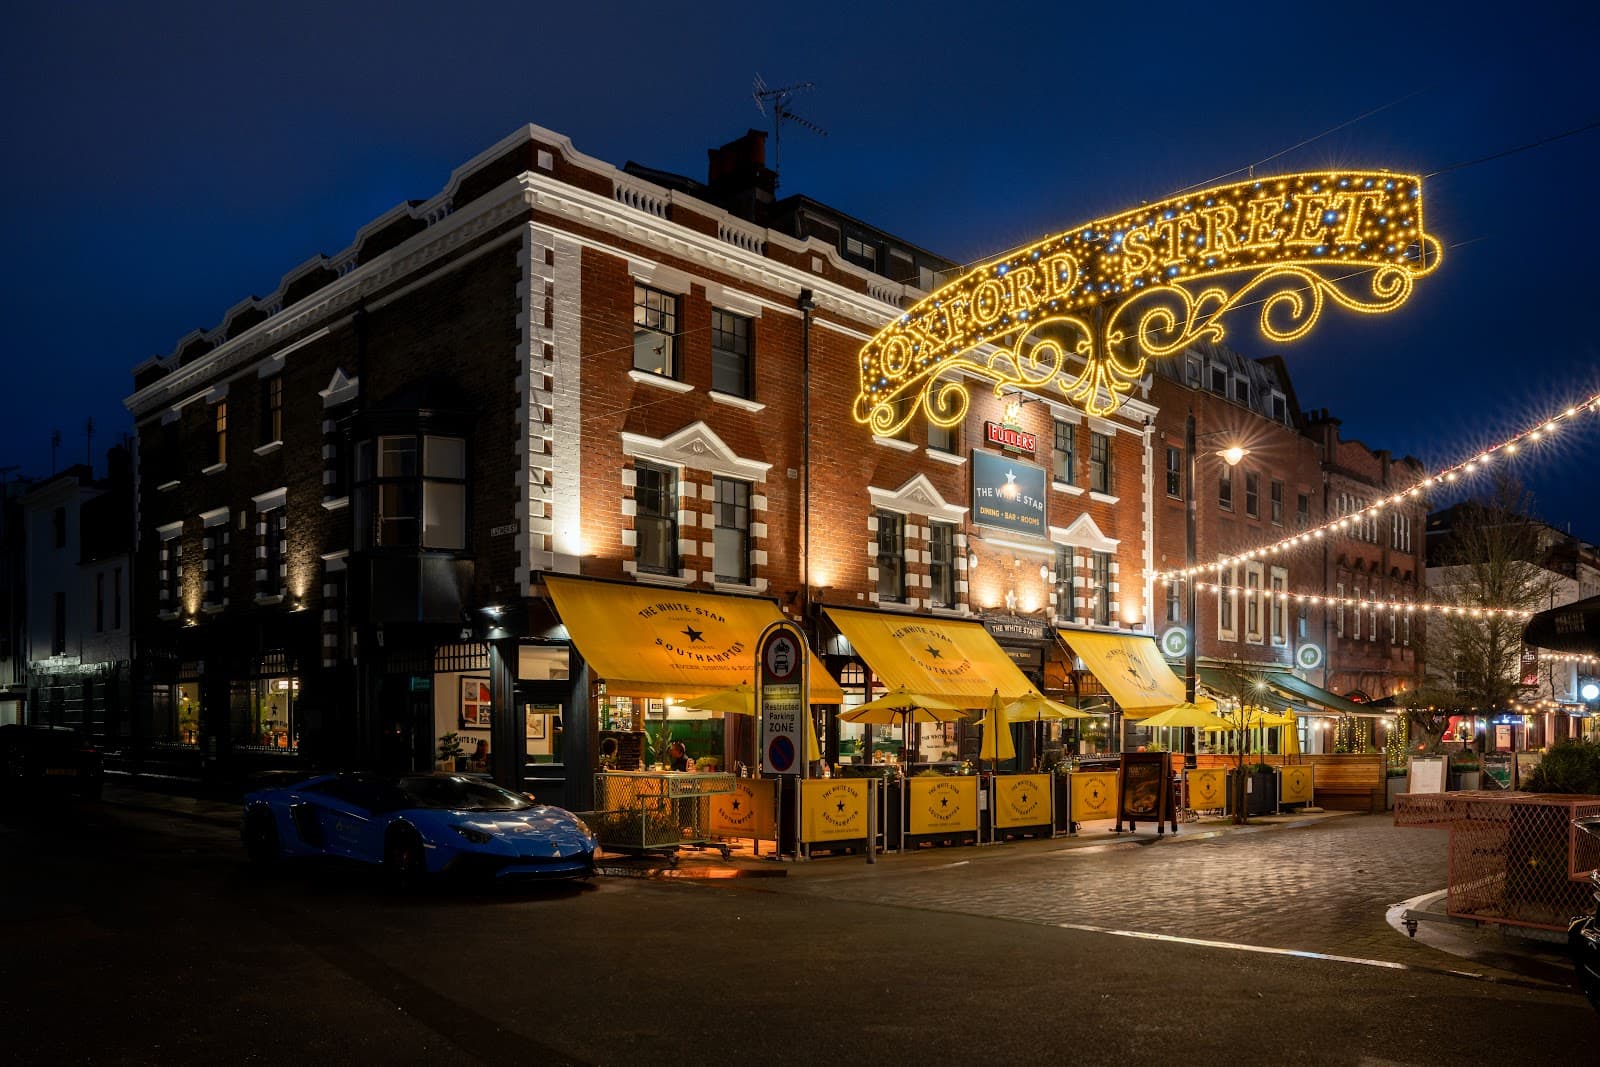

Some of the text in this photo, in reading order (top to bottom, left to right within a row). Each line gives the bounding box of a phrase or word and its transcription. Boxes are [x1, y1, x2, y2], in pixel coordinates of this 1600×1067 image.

[880, 190, 1385, 378] OXFORD STREET
[976, 487, 993, 497] THE
[1023, 495, 1043, 512] STAR
[980, 506, 1040, 526] DINING BAR ROOMS
[639, 602, 726, 623] THE WHITE STAR
[892, 625, 953, 644] THE WHITE STAR
[1004, 624, 1023, 633] WHITE
[1023, 626, 1038, 637] STAR
[655, 638, 745, 663] SOUTHAMPTON
[910, 656, 971, 675] SOUTHAMPTON
[769, 712, 795, 722] Parking
[769, 723, 794, 732] ZONE
